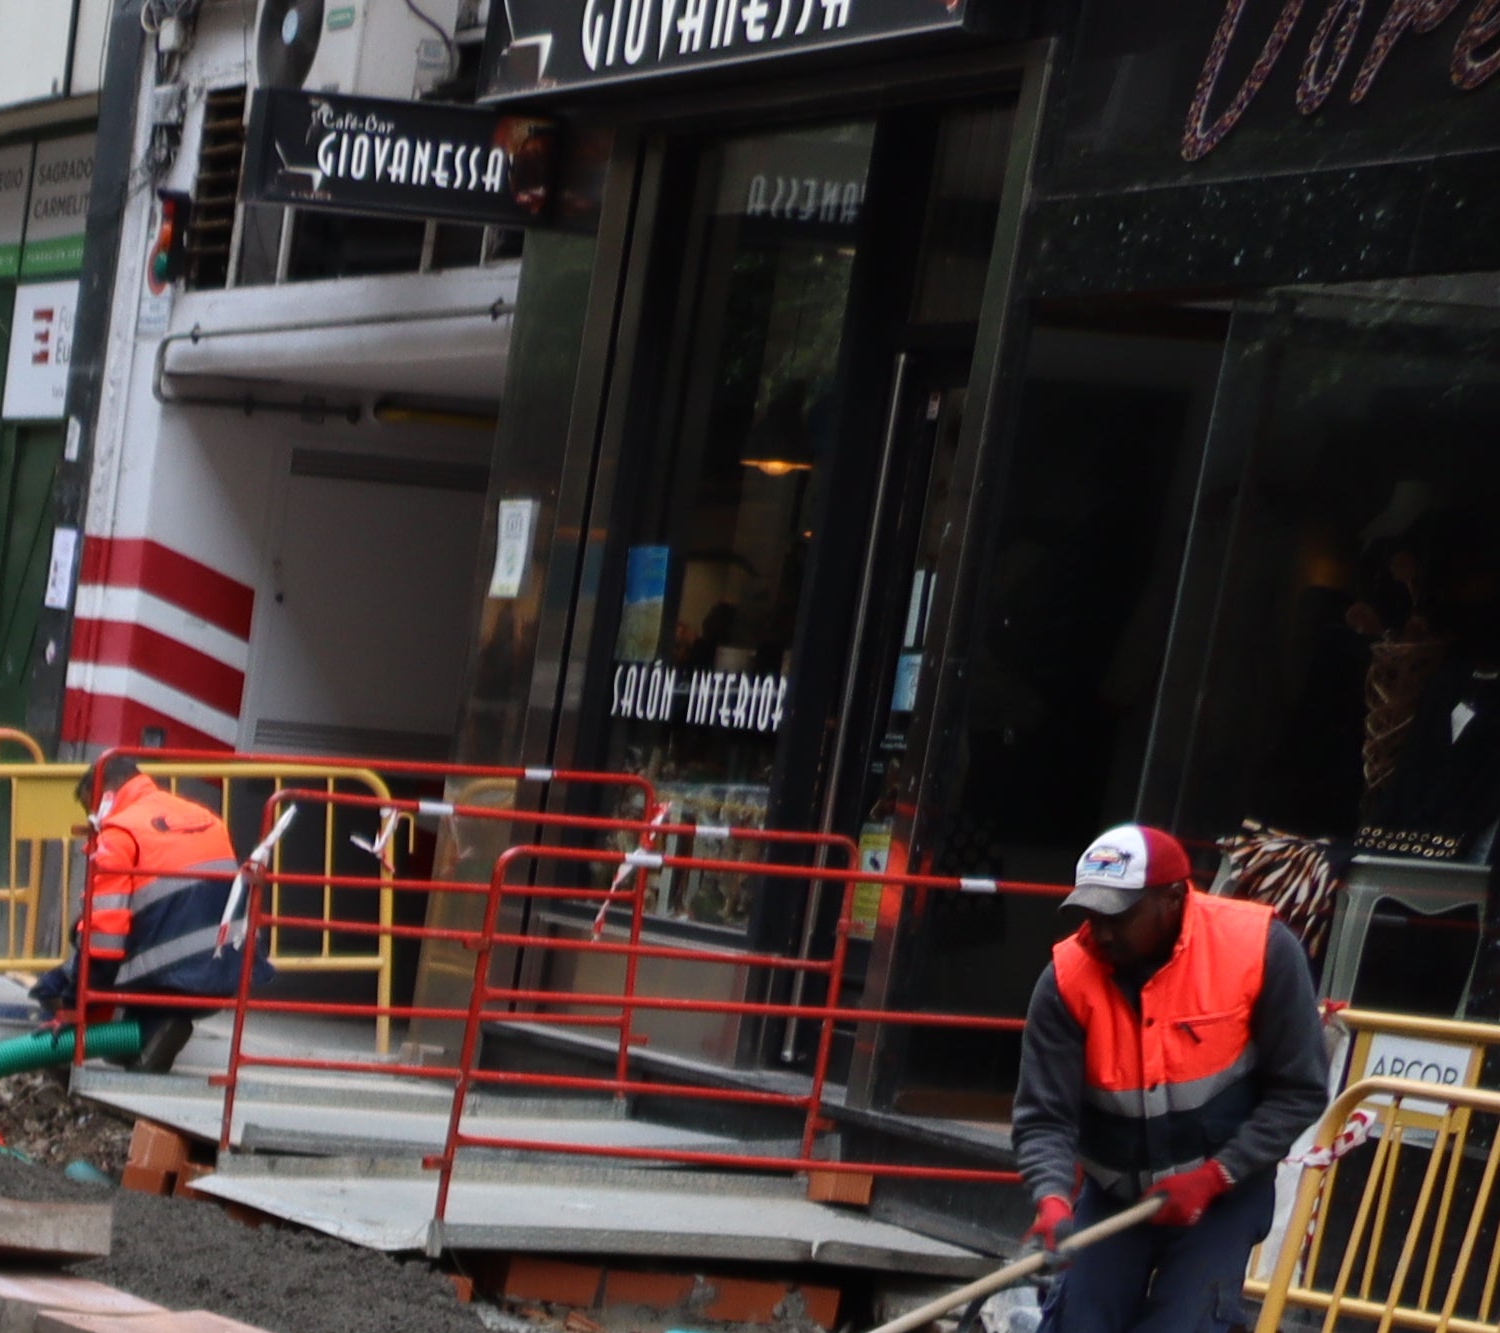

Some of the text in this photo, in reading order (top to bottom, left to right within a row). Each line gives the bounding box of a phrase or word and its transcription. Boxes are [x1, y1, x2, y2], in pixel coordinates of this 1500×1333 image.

[37, 157, 94, 184] SAGRADO
[317, 131, 505, 193] GIOVANESSA
[611, 659, 676, 721] SALÓN
[1371, 1054, 1459, 1085] ARCOR
